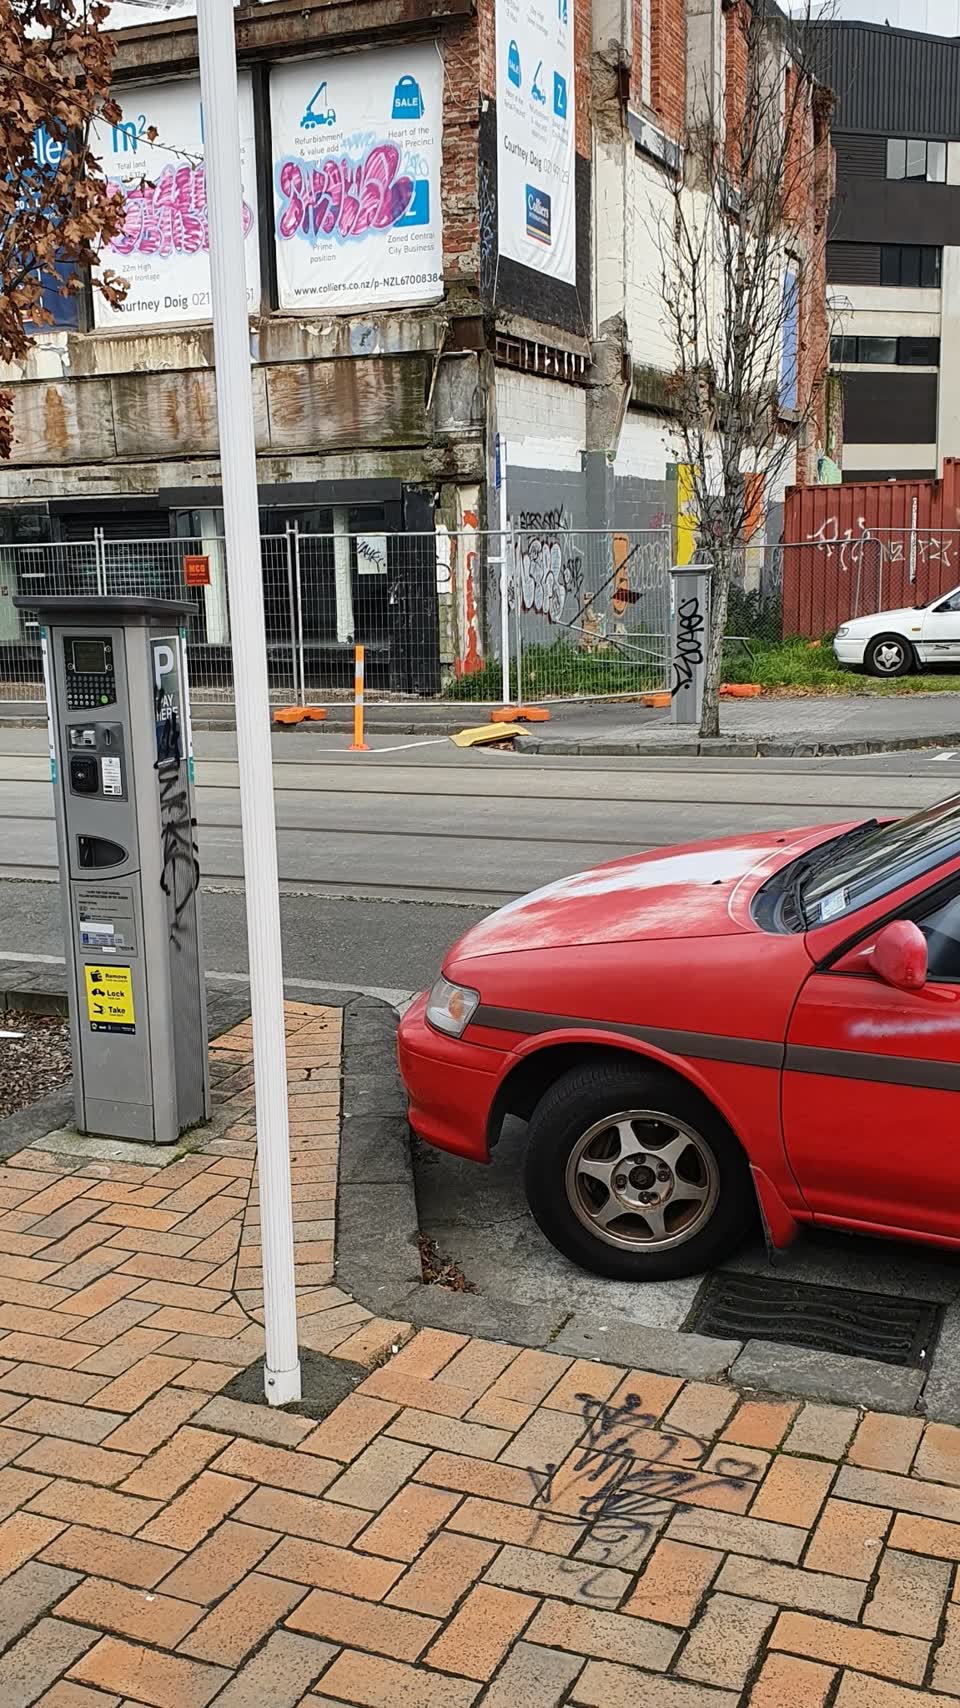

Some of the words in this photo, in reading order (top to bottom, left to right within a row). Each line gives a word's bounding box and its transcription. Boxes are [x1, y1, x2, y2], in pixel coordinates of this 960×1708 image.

[395, 97, 418, 107] SALE
[295, 133, 343, 145] Refurbishment
[388, 130, 407, 139] Heart
[409, 128, 417, 136] of
[418, 127, 430, 135] the
[405, 138, 434, 147] Precinct
[307, 148, 324, 156] value
[326, 145, 339, 154] add
[504, 135, 528, 165] Courtney
[530, 151, 541, 172] Doig
[117, 161, 131, 169] Total
[133, 160, 146, 168] land
[528, 193, 549, 219] Colliers
[387, 235, 408, 244] Zoned
[410, 232, 434, 241] Central
[313, 243, 333, 251] Prime
[388, 246, 402, 255] City
[404, 243, 434, 253] Business
[310, 254, 336, 263] position
[122, 264, 136, 272] 22m
[164, 294, 189, 309] Doig
[154, 645, 174, 690] P
[161, 694, 174, 707] AY
[108, 1006, 126, 1014] Take
